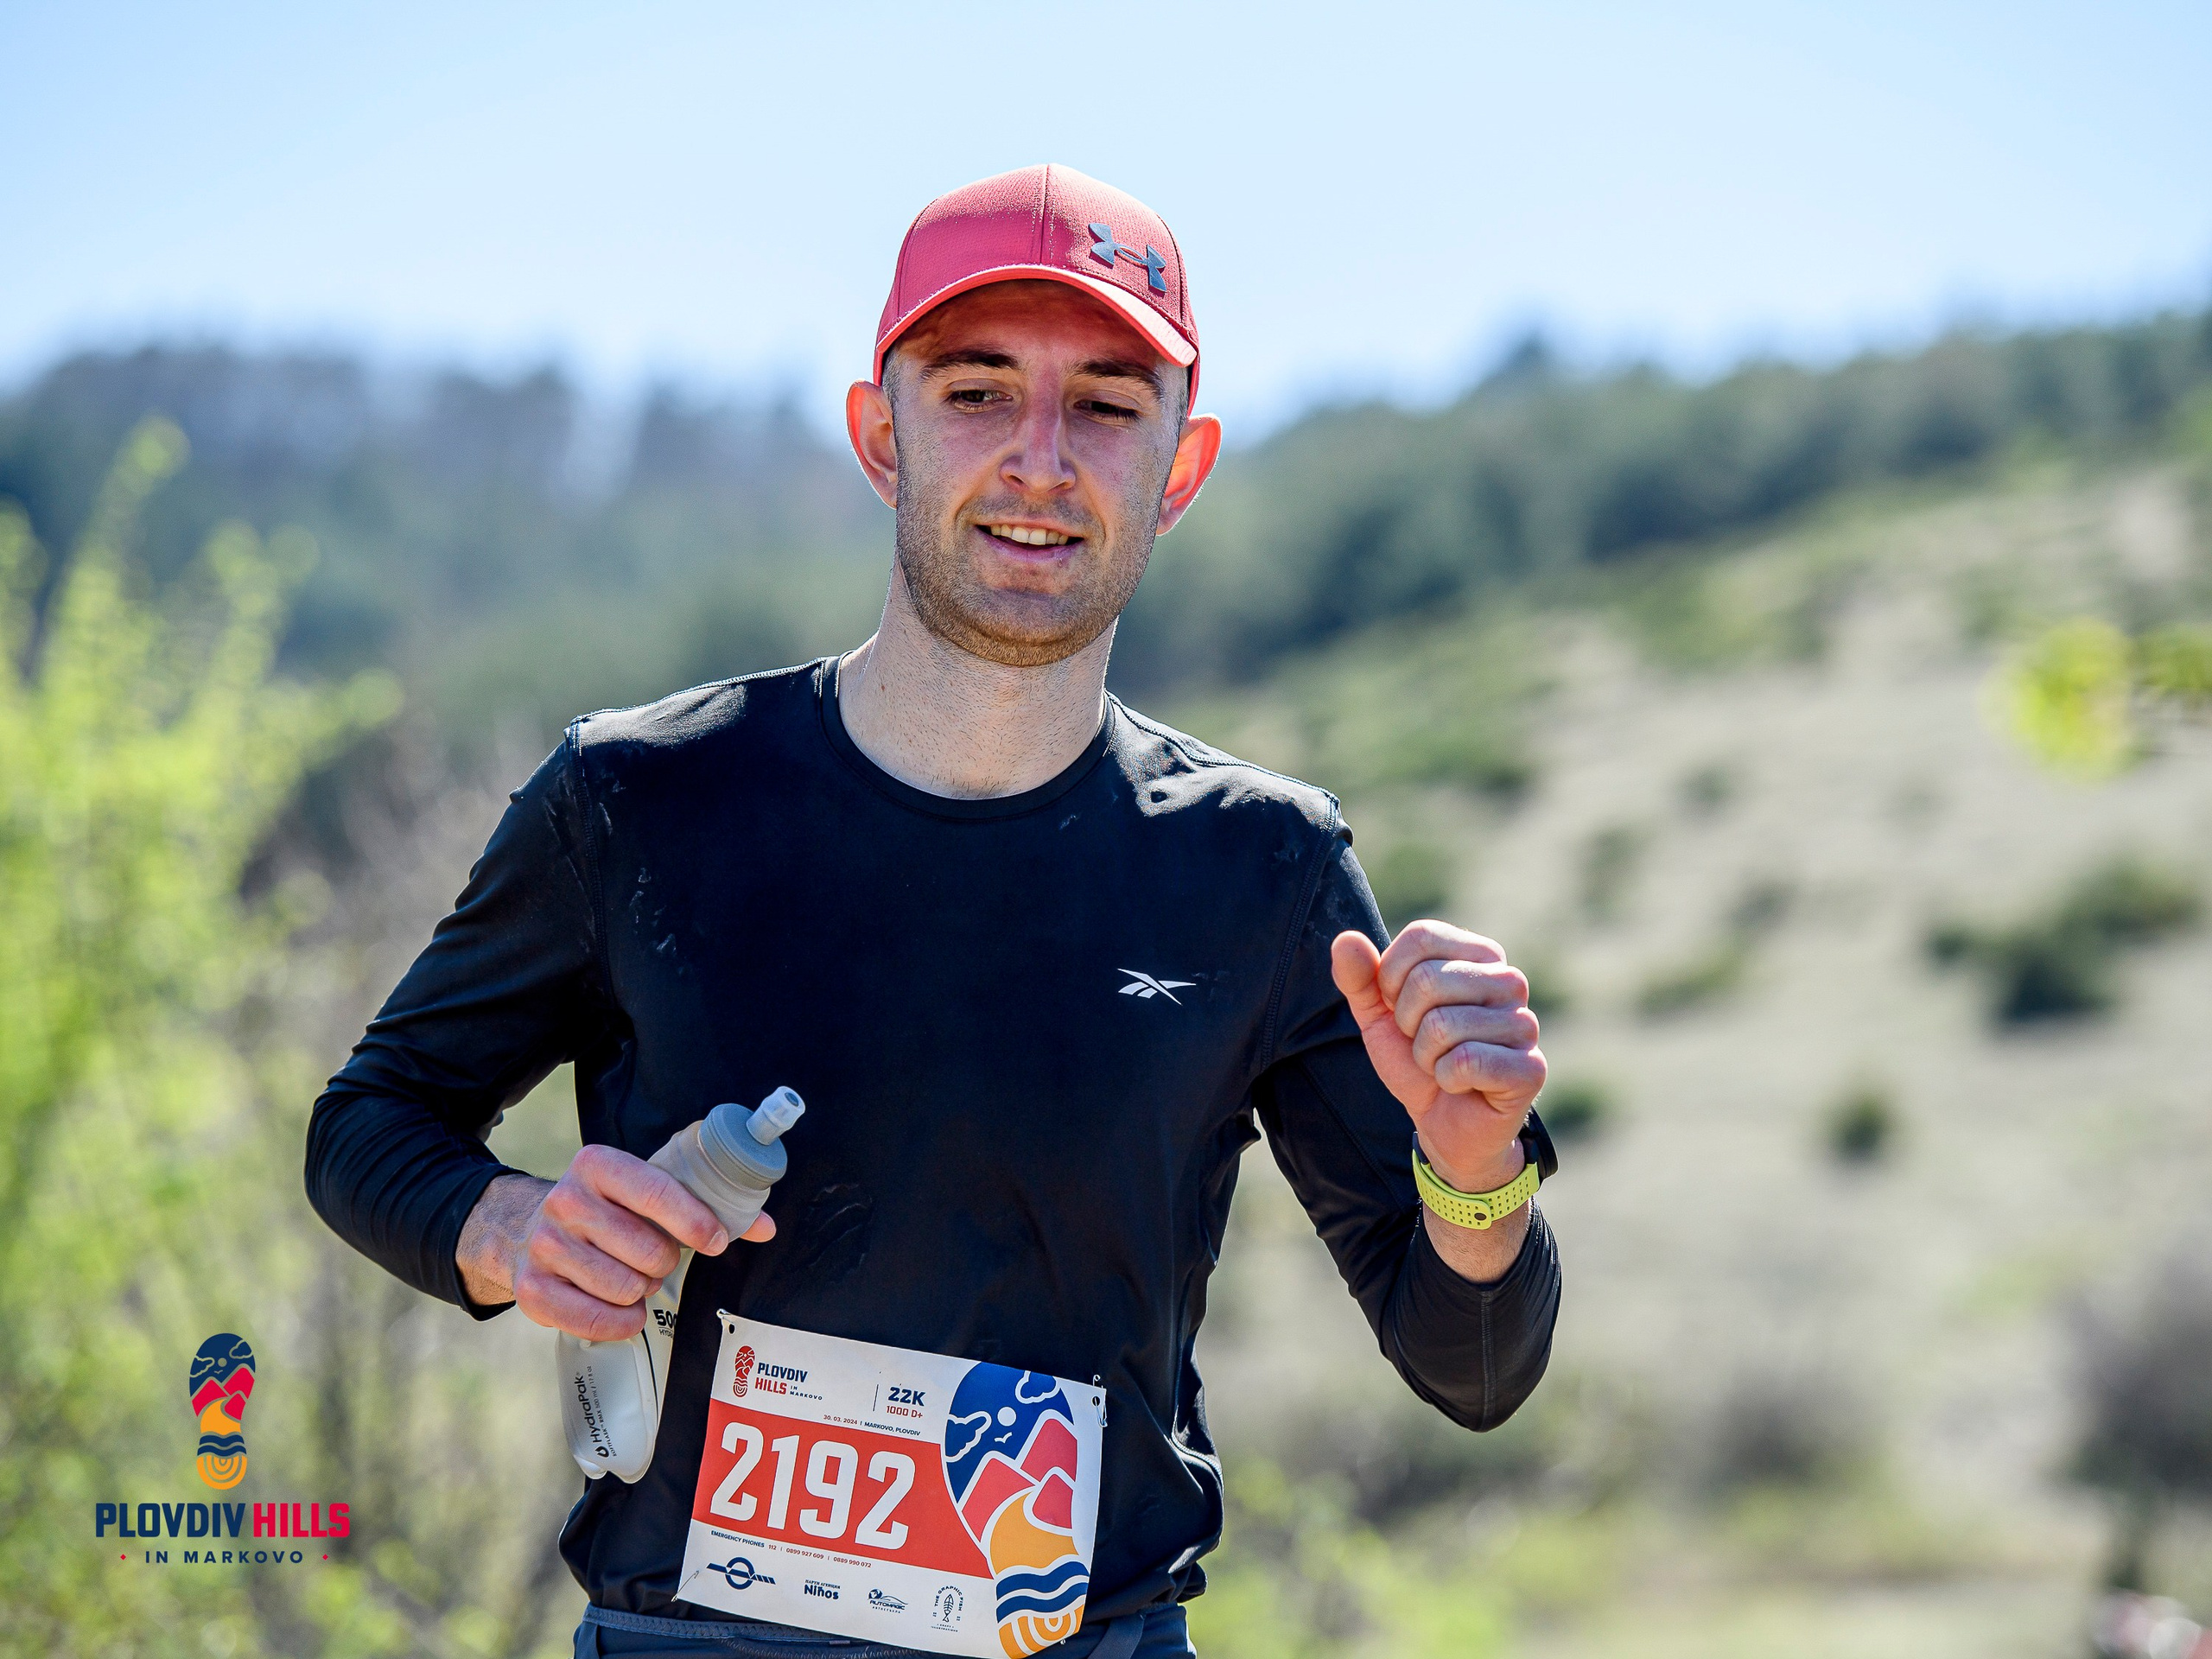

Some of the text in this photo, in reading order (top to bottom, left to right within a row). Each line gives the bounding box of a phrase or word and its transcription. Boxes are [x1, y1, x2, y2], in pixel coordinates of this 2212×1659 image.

[757, 1362, 809, 1382] PLOVDIV
[754, 1377, 787, 1395] HILLS
[789, 1390, 823, 1401] MARKOVO
[887, 1386, 925, 1407] 22K
[886, 1405, 924, 1419] 1000 D+
[843, 1417, 858, 1426] 2024
[864, 1421, 894, 1433] MARKOVO,
[895, 1427, 921, 1436] PLOVDIV
[709, 1421, 916, 1550] 2192
[711, 1529, 742, 1543] EMERGENCY
[742, 1538, 765, 1548] PHONES
[938, 1586, 963, 1597] GRAPHIC
[869, 1599, 906, 1611] AUTOMAGIC
